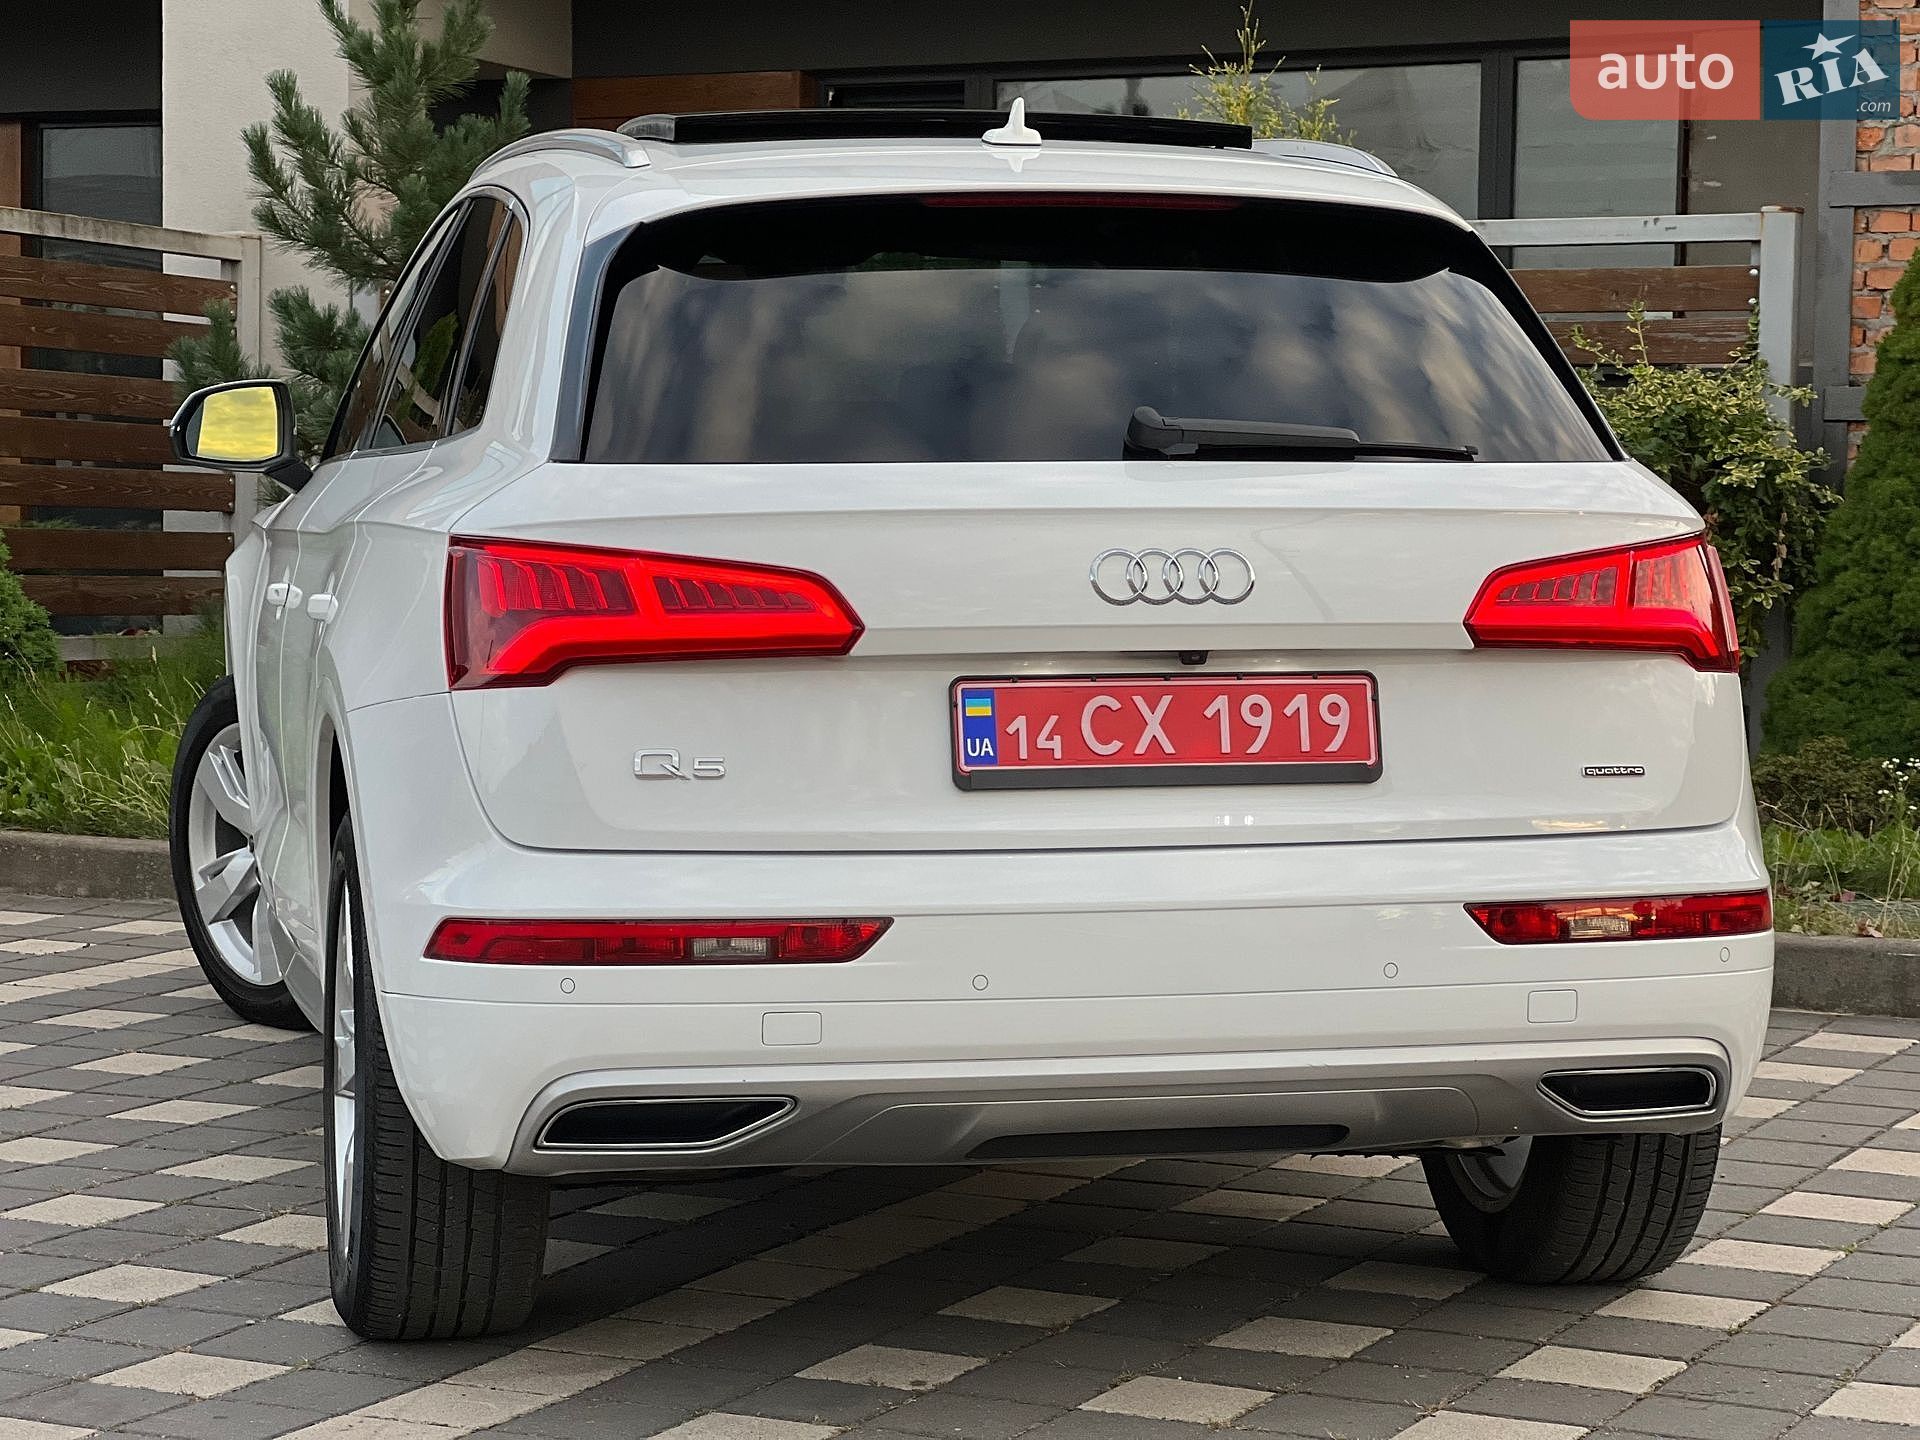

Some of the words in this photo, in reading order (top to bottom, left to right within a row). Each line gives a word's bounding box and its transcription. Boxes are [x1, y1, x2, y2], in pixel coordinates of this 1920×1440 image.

[1005, 714, 1063, 760] 14
[1080, 694, 1177, 756] CX
[1202, 693, 1351, 755] 1919
[966, 737, 995, 757] UA
[1585, 766, 1645, 777] quattro
